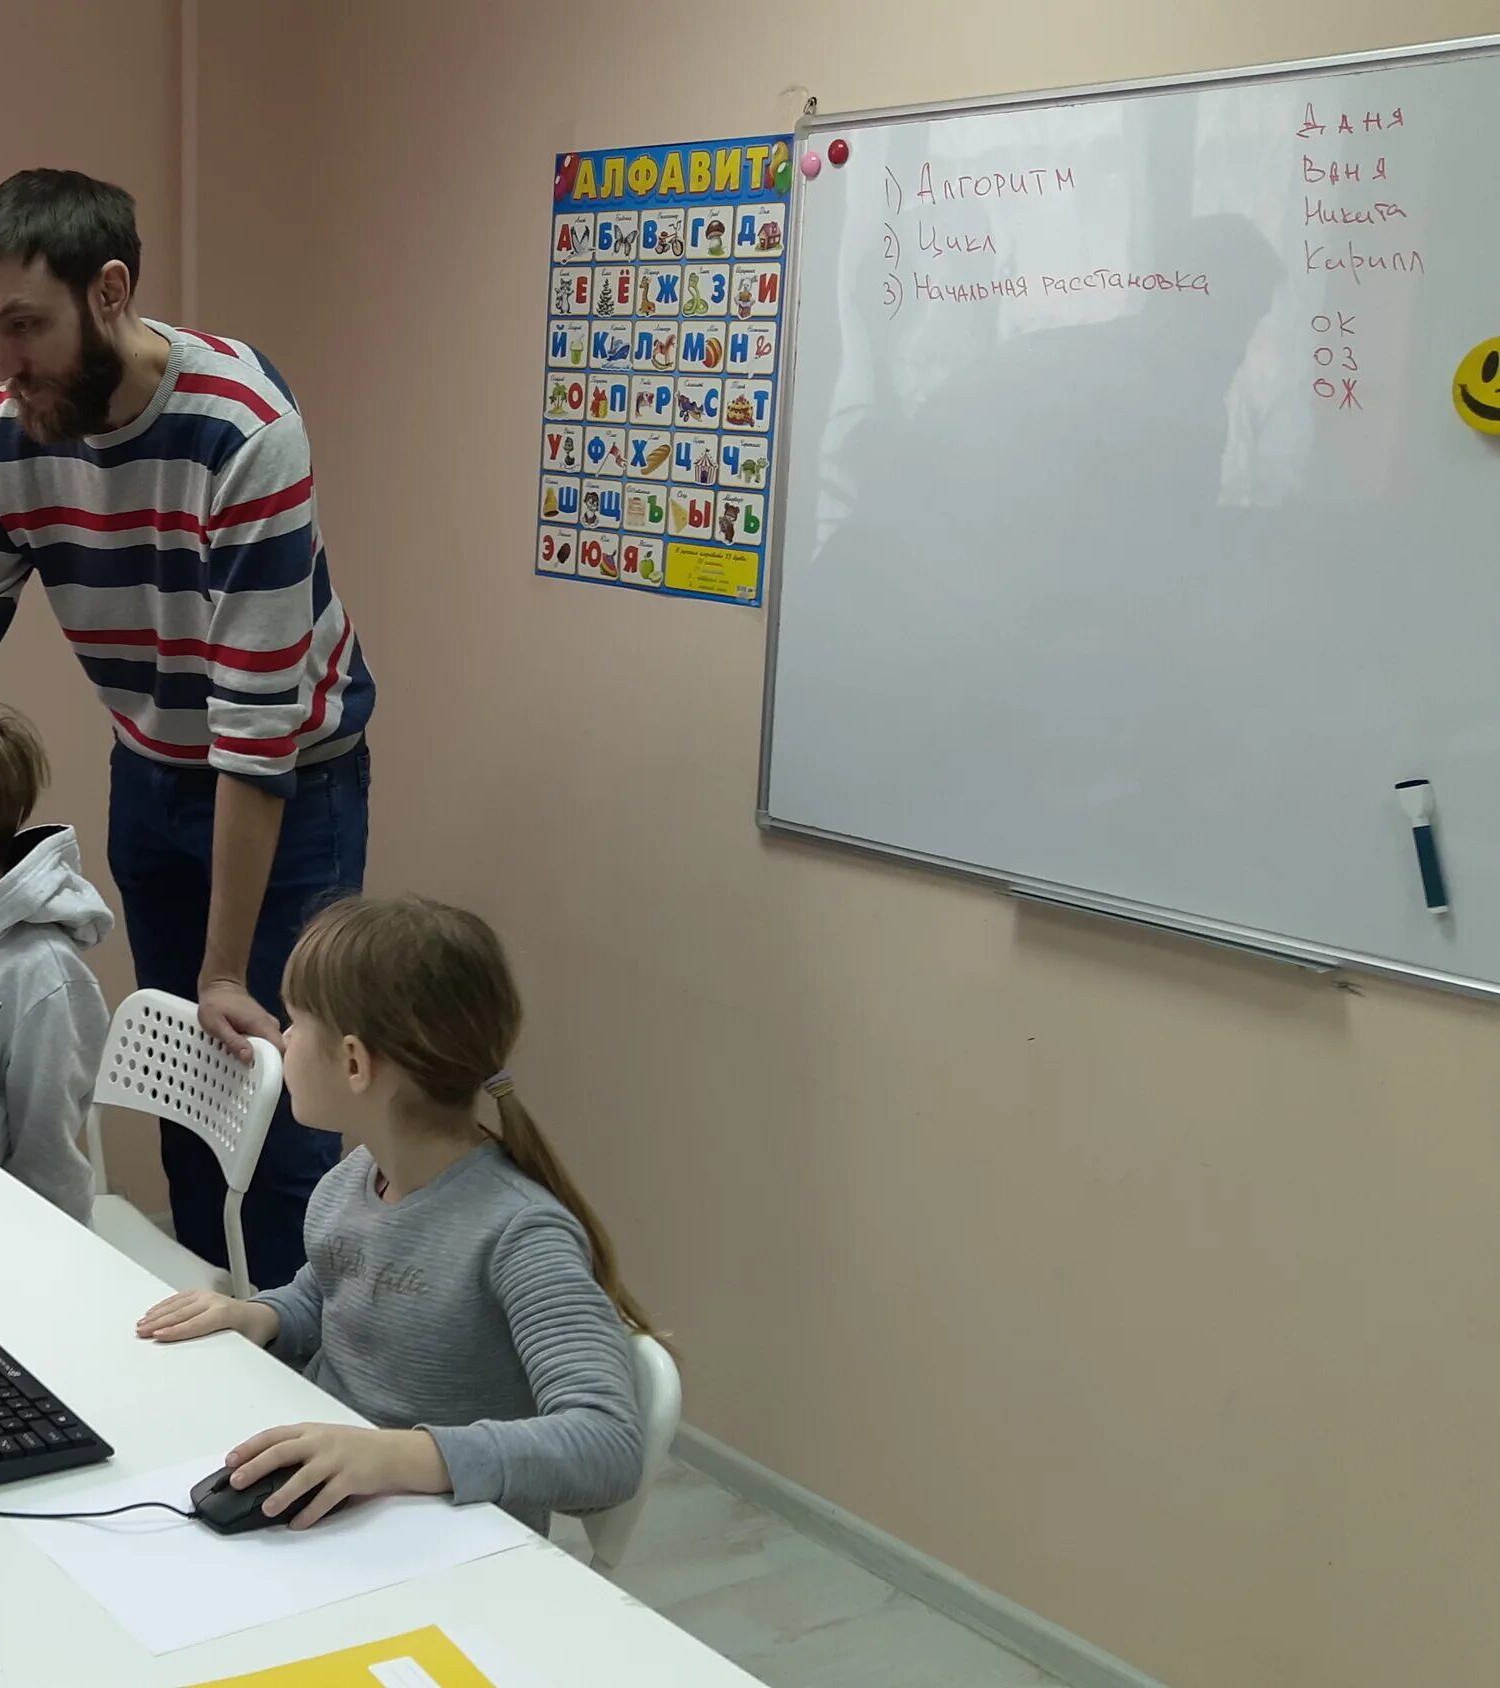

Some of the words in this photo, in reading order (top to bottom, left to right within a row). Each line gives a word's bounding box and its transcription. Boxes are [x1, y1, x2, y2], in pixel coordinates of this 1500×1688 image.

[572, 146, 770, 201] АЛФАВИТ
[1304, 196, 1407, 226] Никита
[556, 224, 573, 252] А
[598, 222, 613, 251] Б
[643, 220, 658, 250] В
[691, 217, 705, 248] Г
[737, 215, 756, 247] Д
[917, 220, 997, 258] Цикл
[1304, 240, 1424, 285] Кирилл
[575, 276, 588, 304] Е
[617, 269, 630, 304] Ё
[656, 274, 678, 304] Ж
[710, 274, 726, 304] З
[758, 273, 778, 304] И
[551, 324, 568, 359] Й
[593, 332, 609, 359] К
[634, 332, 653, 360] Л
[682, 332, 706, 362] М
[729, 333, 749, 363] Н
[567, 382, 583, 410] О
[609, 384, 627, 413] П
[655, 386, 672, 415] Р
[704, 388, 719, 418] С
[753, 390, 769, 420] Т
[547, 433, 562, 461] У
[587, 436, 606, 464] Ф
[630, 439, 648, 468] Х
[675, 441, 691, 471] Ц
[722, 445, 740, 475] Ч
[558, 486, 578, 514] Ш
[599, 490, 621, 522] Щ
[647, 495, 664, 523] Ъ
[688, 498, 710, 529] Ы
[743, 505, 760, 534] Ь
[542, 534, 555, 561] Э
[581, 540, 602, 568] Ю
[623, 545, 639, 574] Я
